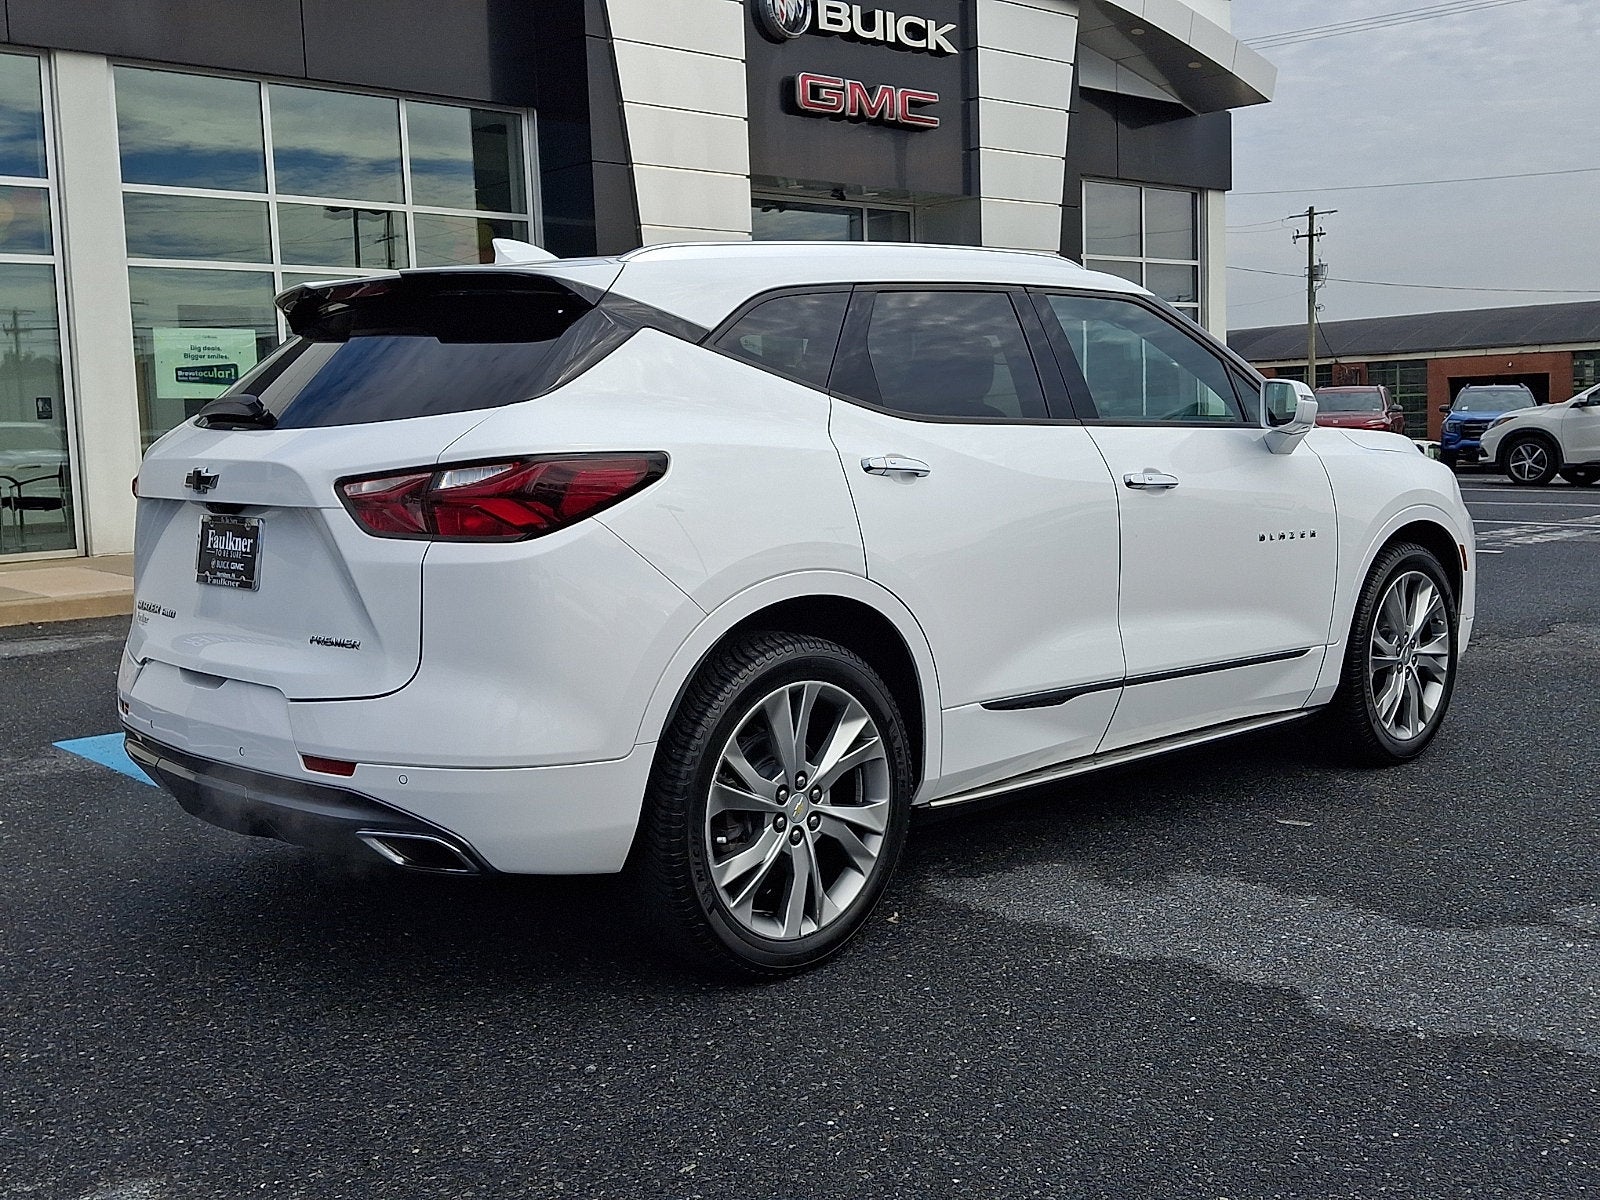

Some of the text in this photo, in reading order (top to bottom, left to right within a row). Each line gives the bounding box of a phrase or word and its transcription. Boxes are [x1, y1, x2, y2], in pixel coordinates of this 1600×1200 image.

[817, 0, 959, 54] BUICK
[797, 72, 940, 128] GMC
[207, 529, 253, 552] Faulkner
[1259, 530, 1317, 541] BLAZER
[230, 562, 245, 571] GMC
[310, 635, 361, 650] PREMIER
